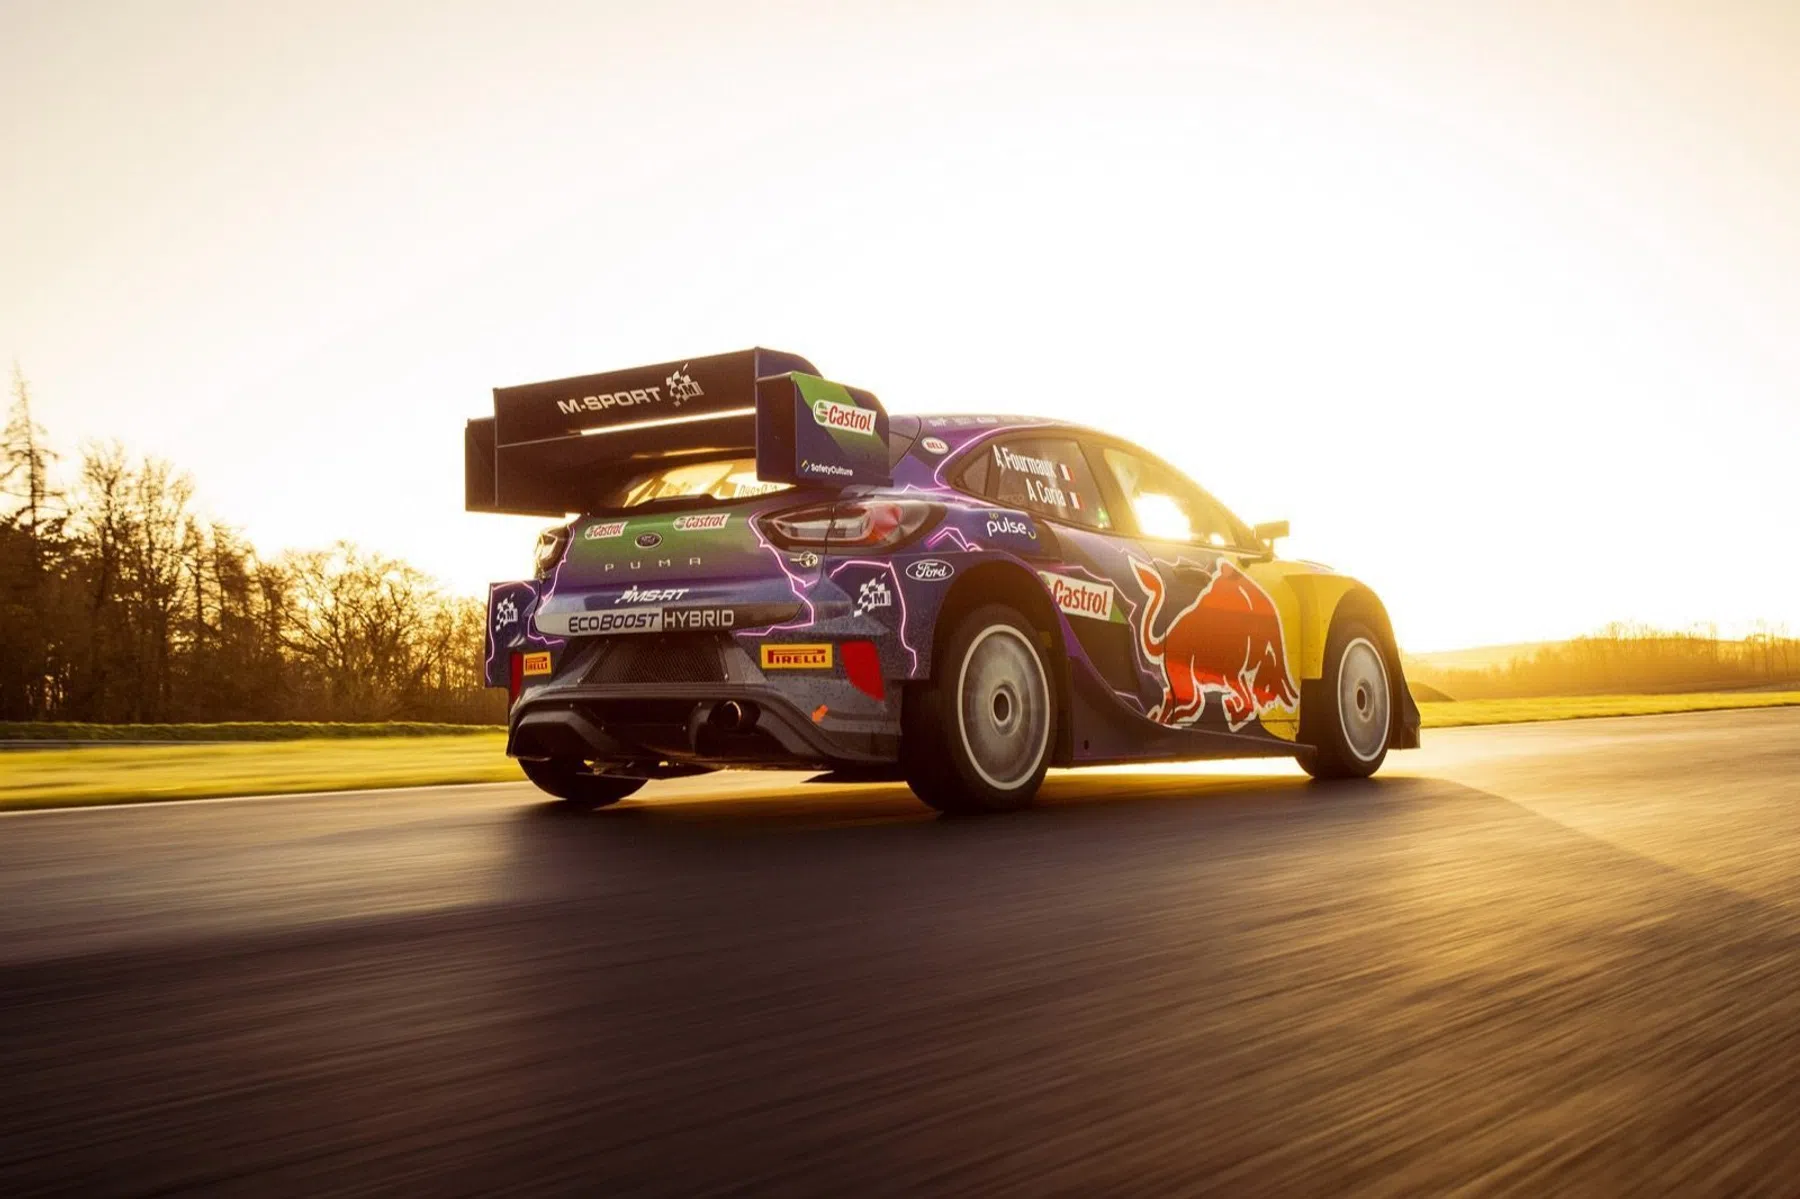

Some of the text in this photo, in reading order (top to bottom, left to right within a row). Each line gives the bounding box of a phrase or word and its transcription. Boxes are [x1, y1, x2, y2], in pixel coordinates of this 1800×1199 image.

[557, 386, 661, 414] M-SPORT
[828, 404, 873, 432] Castrol
[926, 440, 945, 450] BELL
[992, 444, 1057, 478] A Fourmaux
[1026, 478, 1037, 501] A
[593, 523, 622, 537] Castrol
[685, 513, 726, 528] Castrol
[986, 516, 1026, 537] pulse
[604, 557, 702, 572] PUMA
[915, 562, 947, 578] Ford
[1053, 578, 1108, 616] Castrol
[664, 609, 734, 628] HYBRID
[767, 649, 826, 664] PIRELLI
